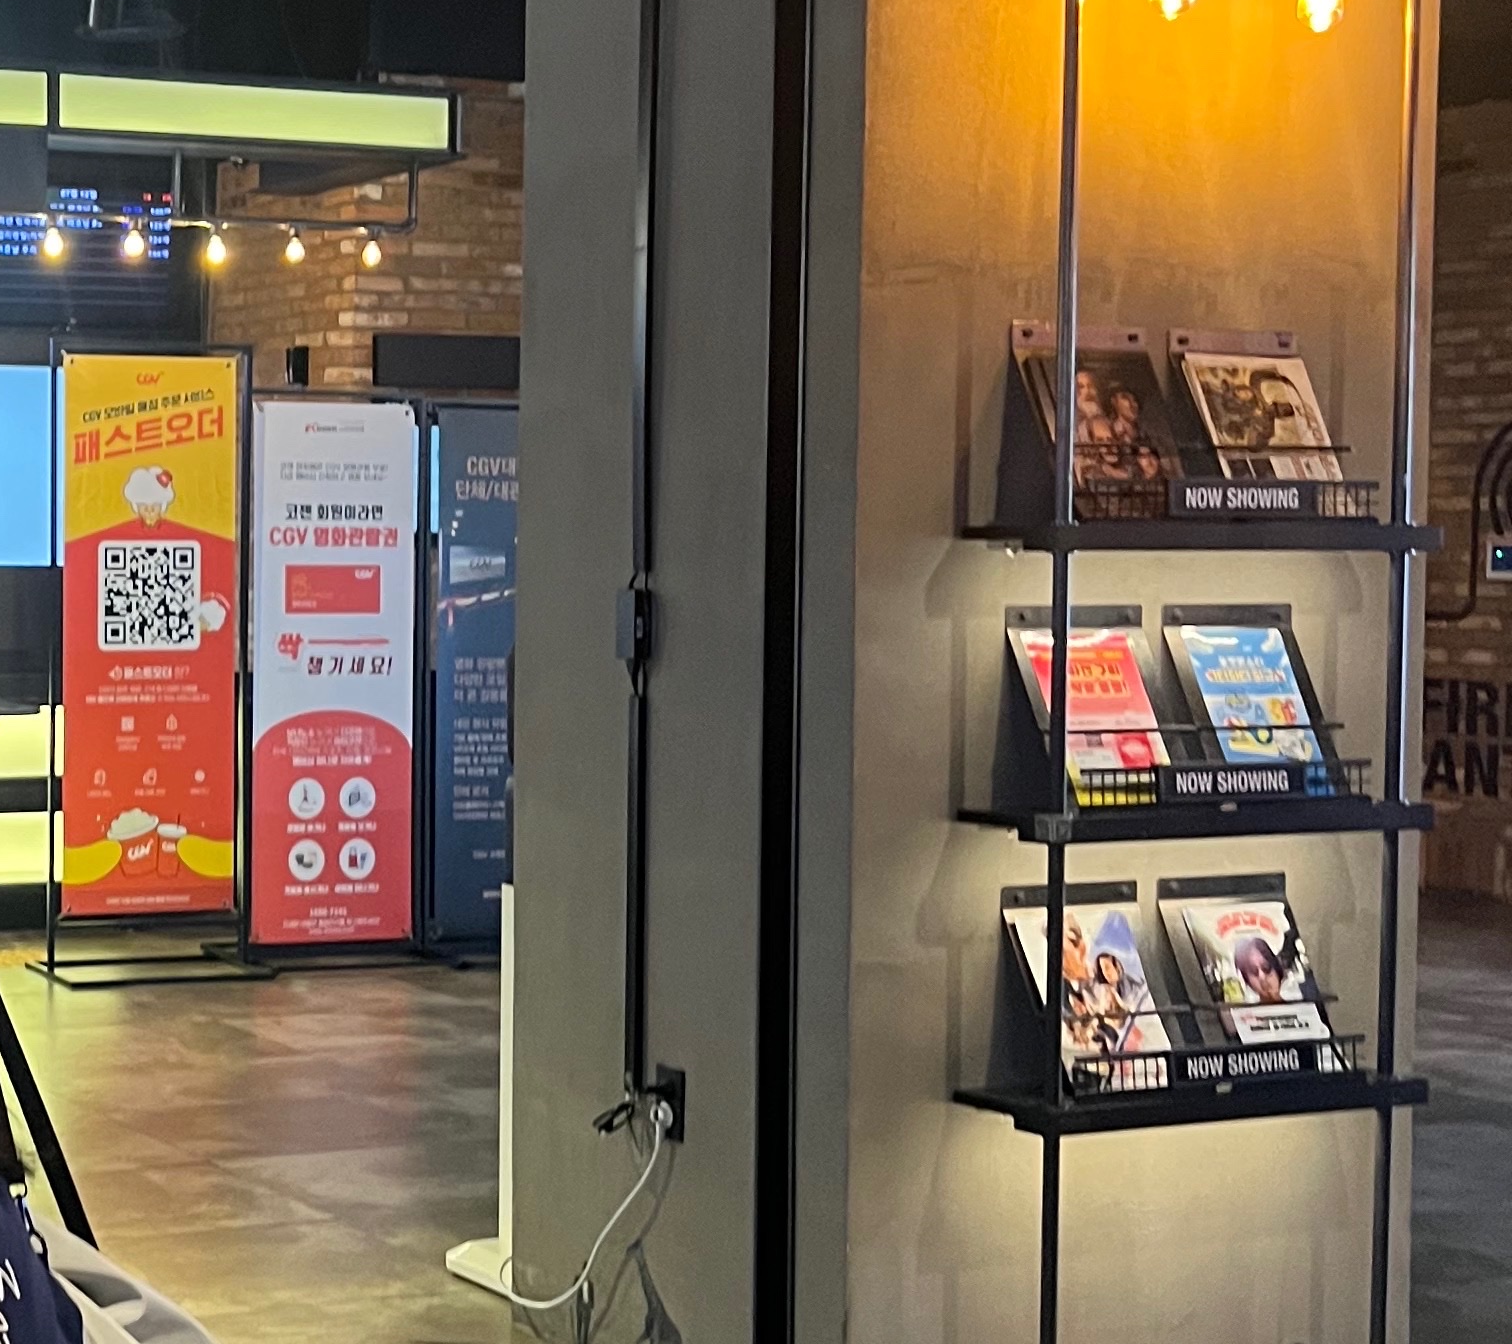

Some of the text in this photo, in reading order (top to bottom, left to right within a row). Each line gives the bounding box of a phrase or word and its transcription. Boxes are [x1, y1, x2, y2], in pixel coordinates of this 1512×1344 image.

[136, 370, 164, 385] CGV
[74, 405, 224, 466] 패스트오더
[466, 456, 517, 477] CGV대
[1186, 486, 1299, 510] NOW SHOWING
[269, 526, 308, 546] CGV
[1176, 768, 1289, 795] NOW SHOWING
[1188, 1047, 1299, 1080] NOW SHOWING
